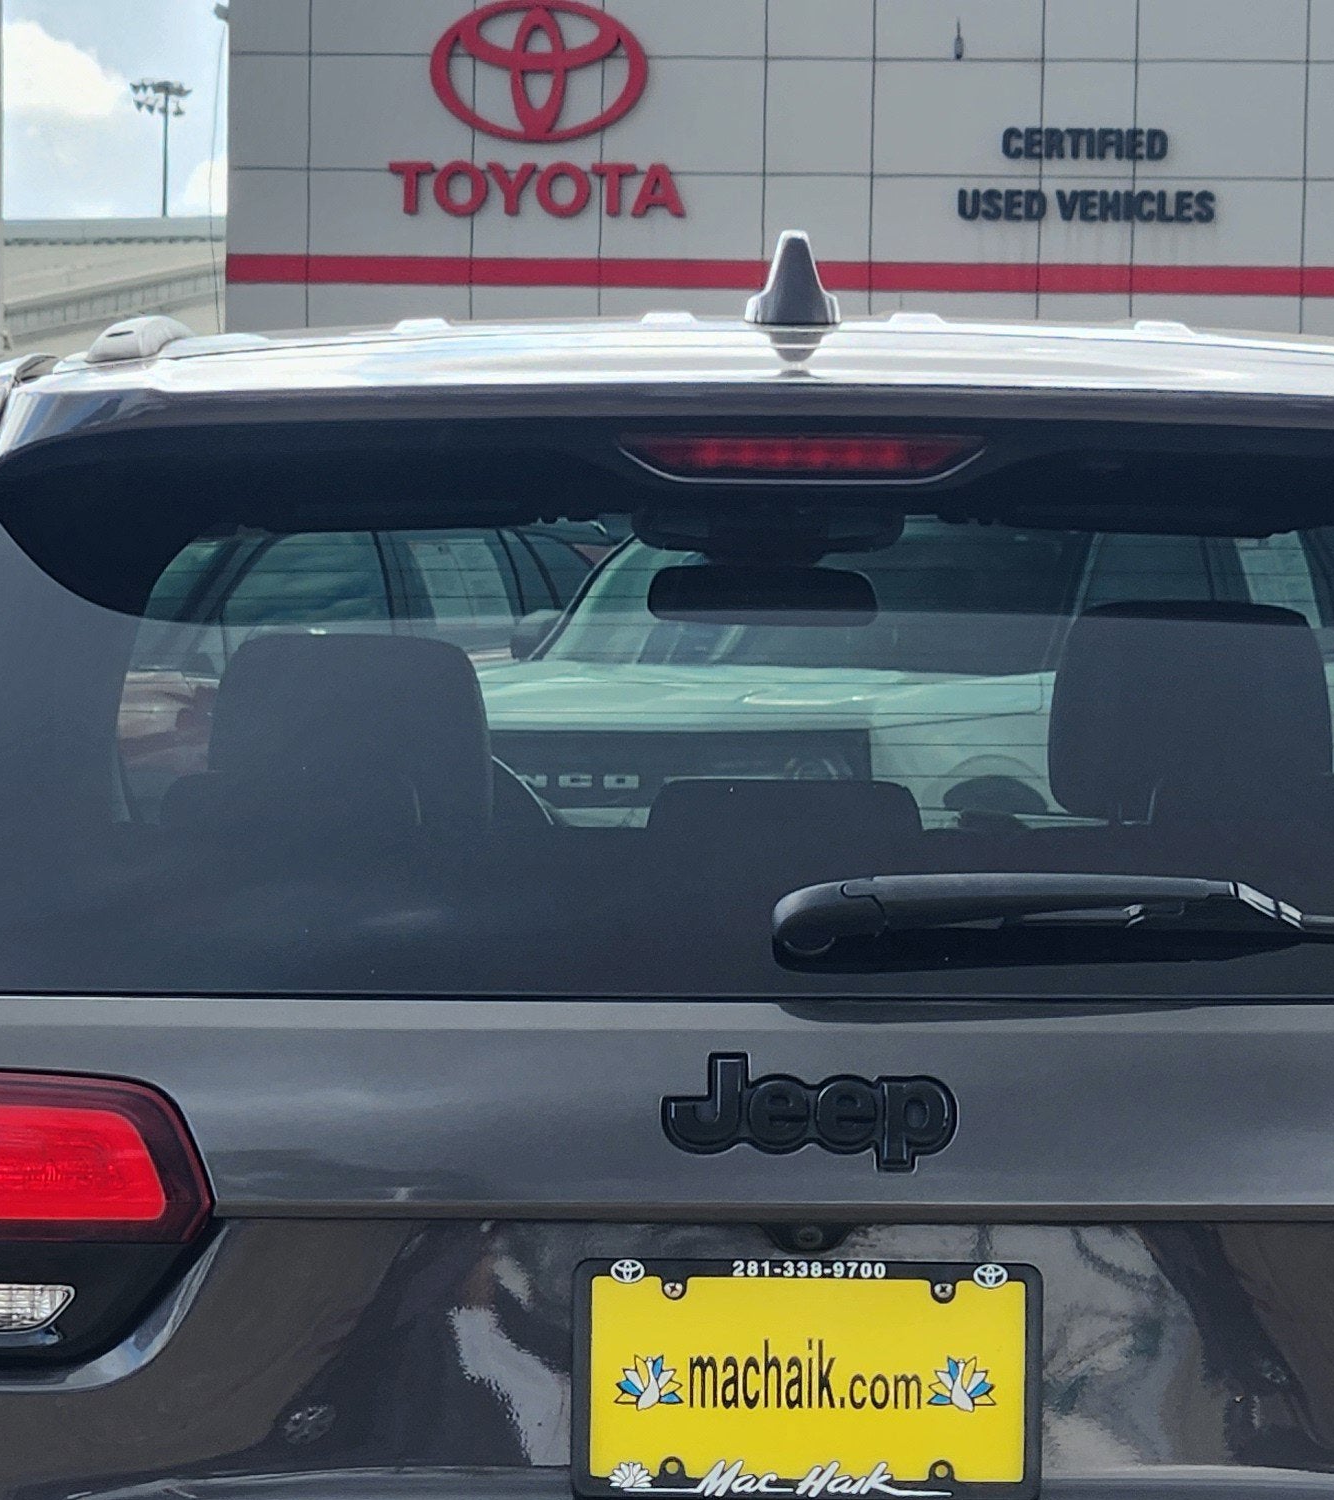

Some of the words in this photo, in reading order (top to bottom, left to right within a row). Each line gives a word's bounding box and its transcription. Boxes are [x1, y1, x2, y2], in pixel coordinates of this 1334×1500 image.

[1002, 127, 1168, 161] CERTIFIED
[389, 160, 686, 218] TOYOTA
[958, 188, 1048, 222] USED
[1056, 189, 1217, 223] VEHICLES
[661, 1052, 959, 1173] Jeep
[732, 1260, 887, 1279] 281-338-9700
[689, 1338, 923, 1410] machaik.com
[693, 1459, 794, 1497] Mac
[795, 1460, 907, 1498] Haik
